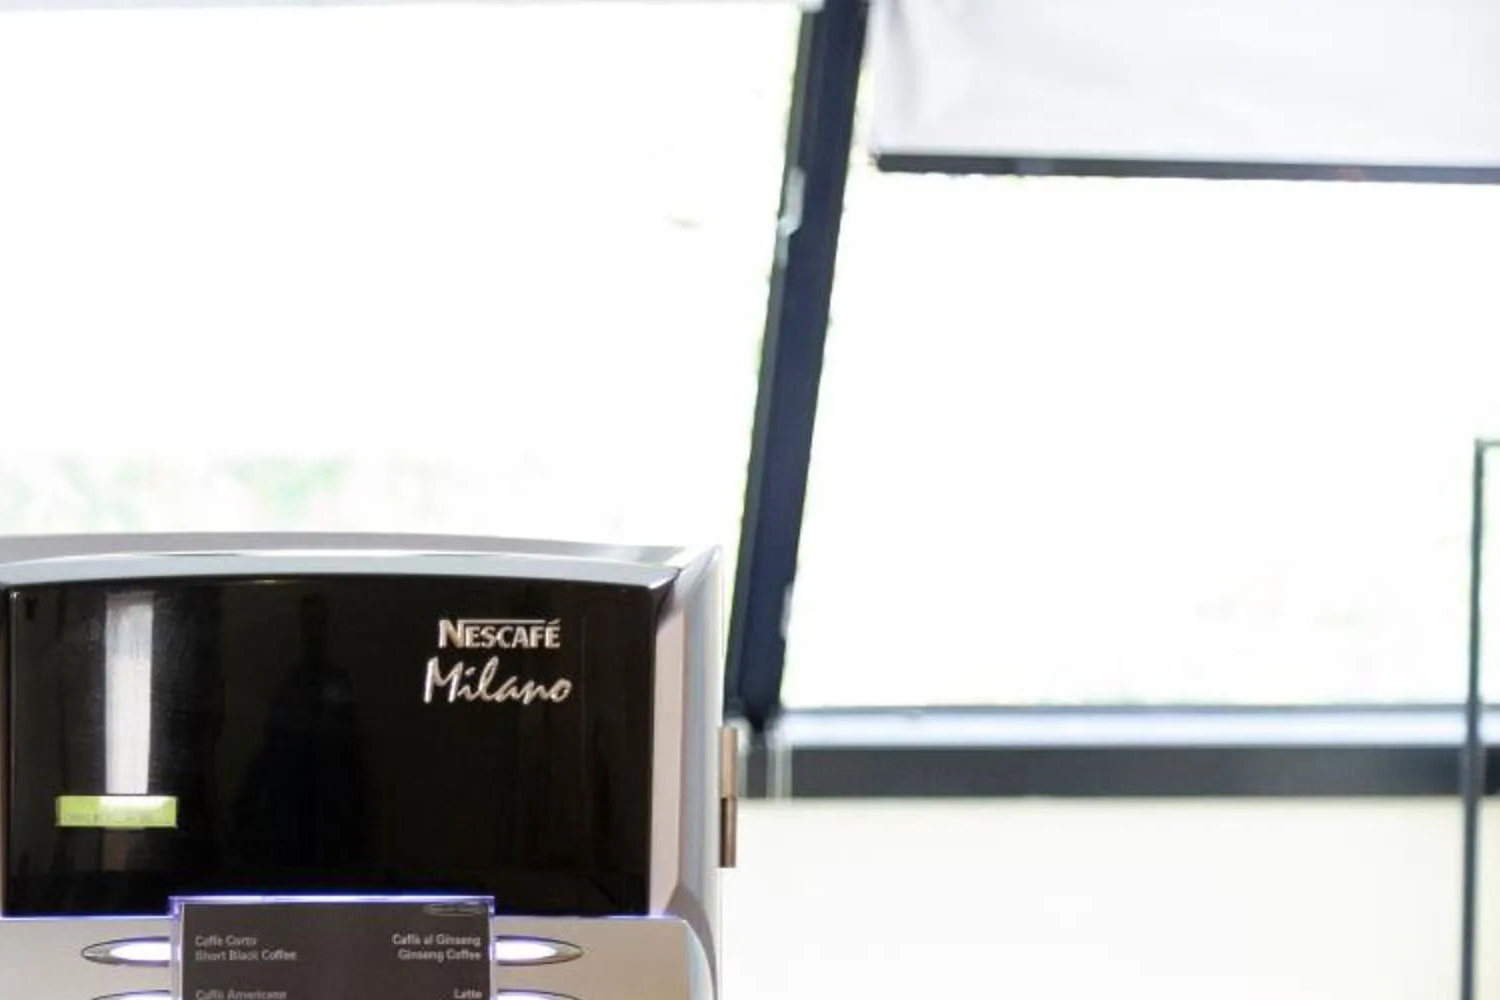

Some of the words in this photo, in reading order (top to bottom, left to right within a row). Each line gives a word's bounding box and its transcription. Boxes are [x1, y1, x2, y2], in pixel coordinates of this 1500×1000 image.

[438, 618, 561, 648] NESCAFÉ
[422, 655, 573, 704] Milano
[436, 932, 481, 948] Ginseng
[195, 949, 227, 961] Short
[229, 949, 259, 961] Black
[261, 949, 298, 961] Coffee
[398, 948, 445, 963] Ginseng
[446, 948, 482, 960] Coffee
[227, 989, 287, 1000] Americano
[454, 988, 483, 999] Latte
